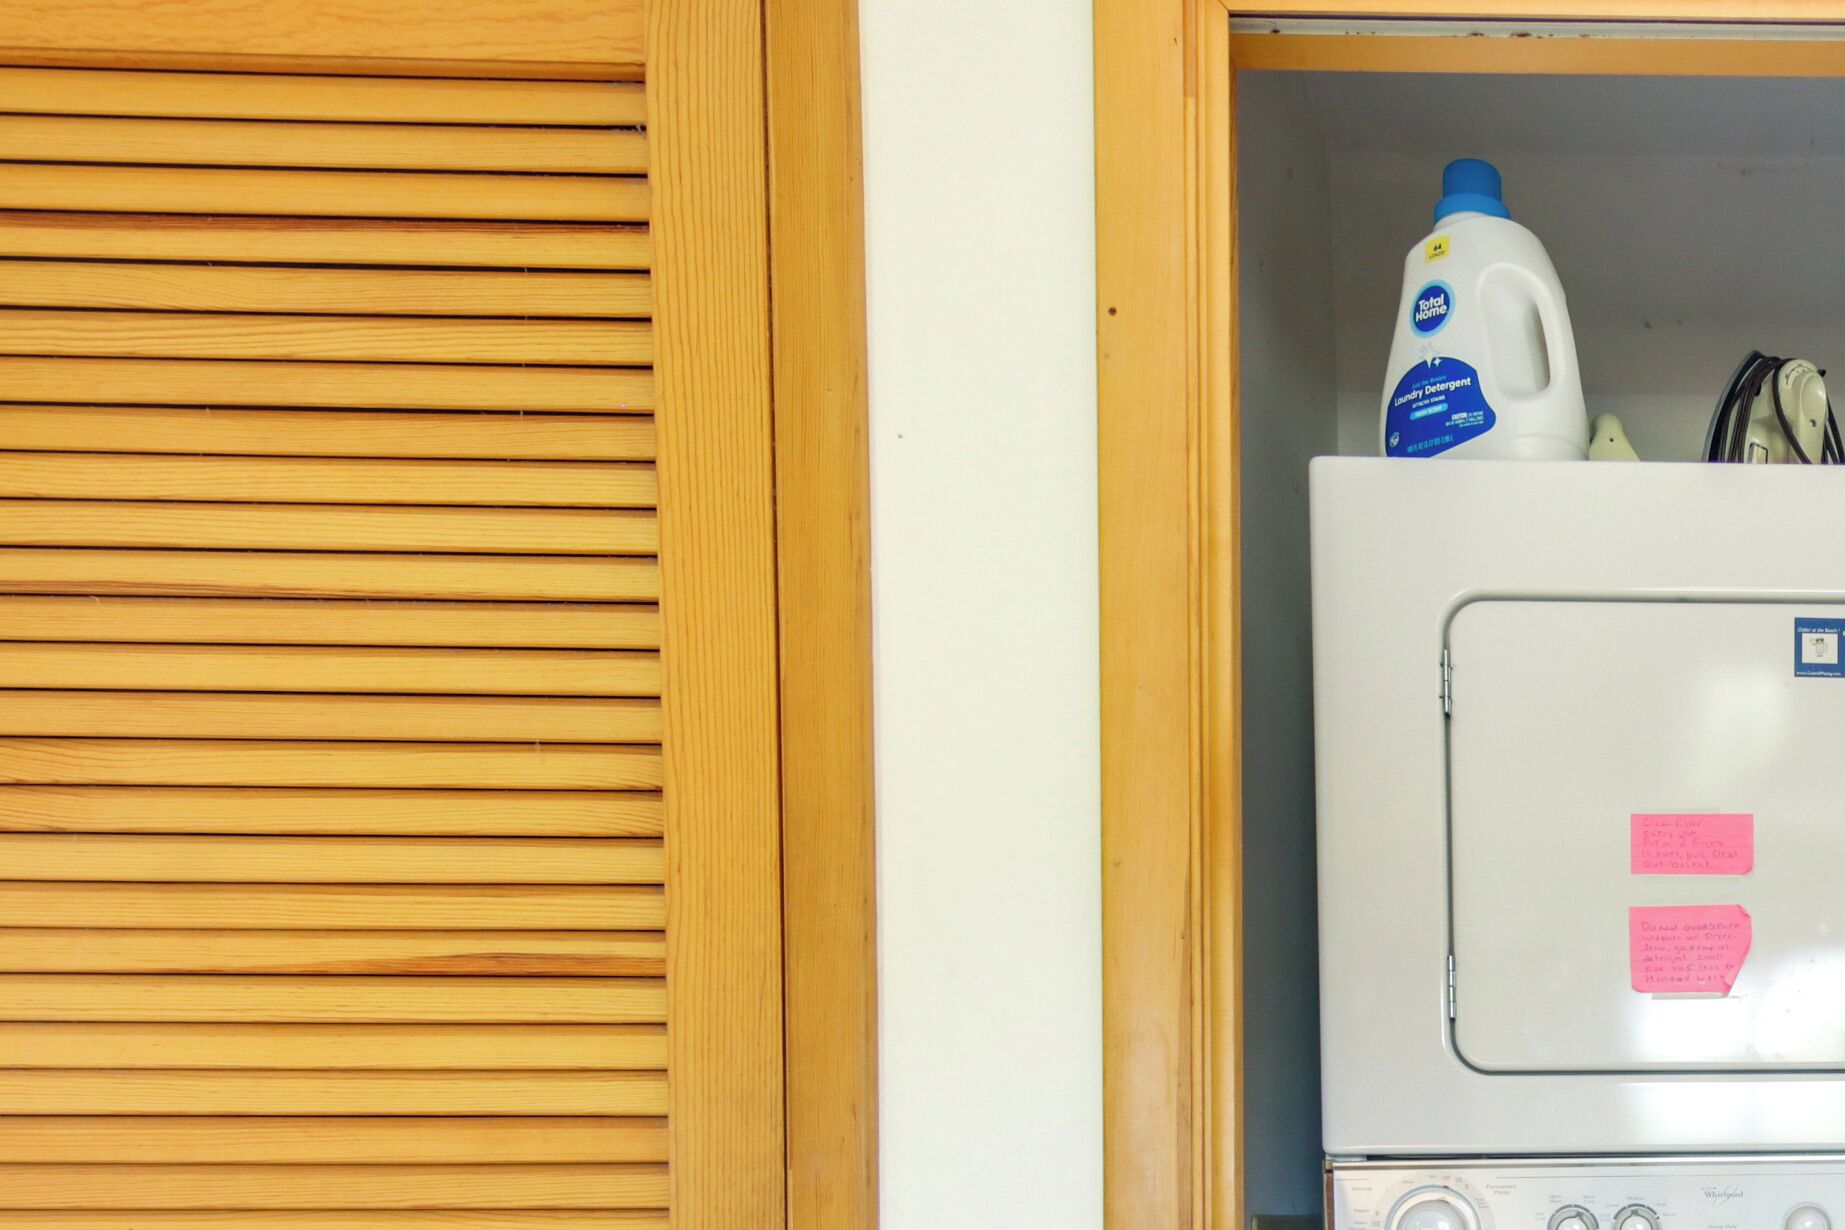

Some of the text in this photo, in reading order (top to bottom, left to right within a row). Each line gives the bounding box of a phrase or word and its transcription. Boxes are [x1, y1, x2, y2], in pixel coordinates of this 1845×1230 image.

[1418, 293, 1445, 311] Total
[1415, 304, 1447, 322] Home
[1394, 376, 1472, 407] Laundry Detergent
[1703, 1189, 1744, 1201] Whirlpool
